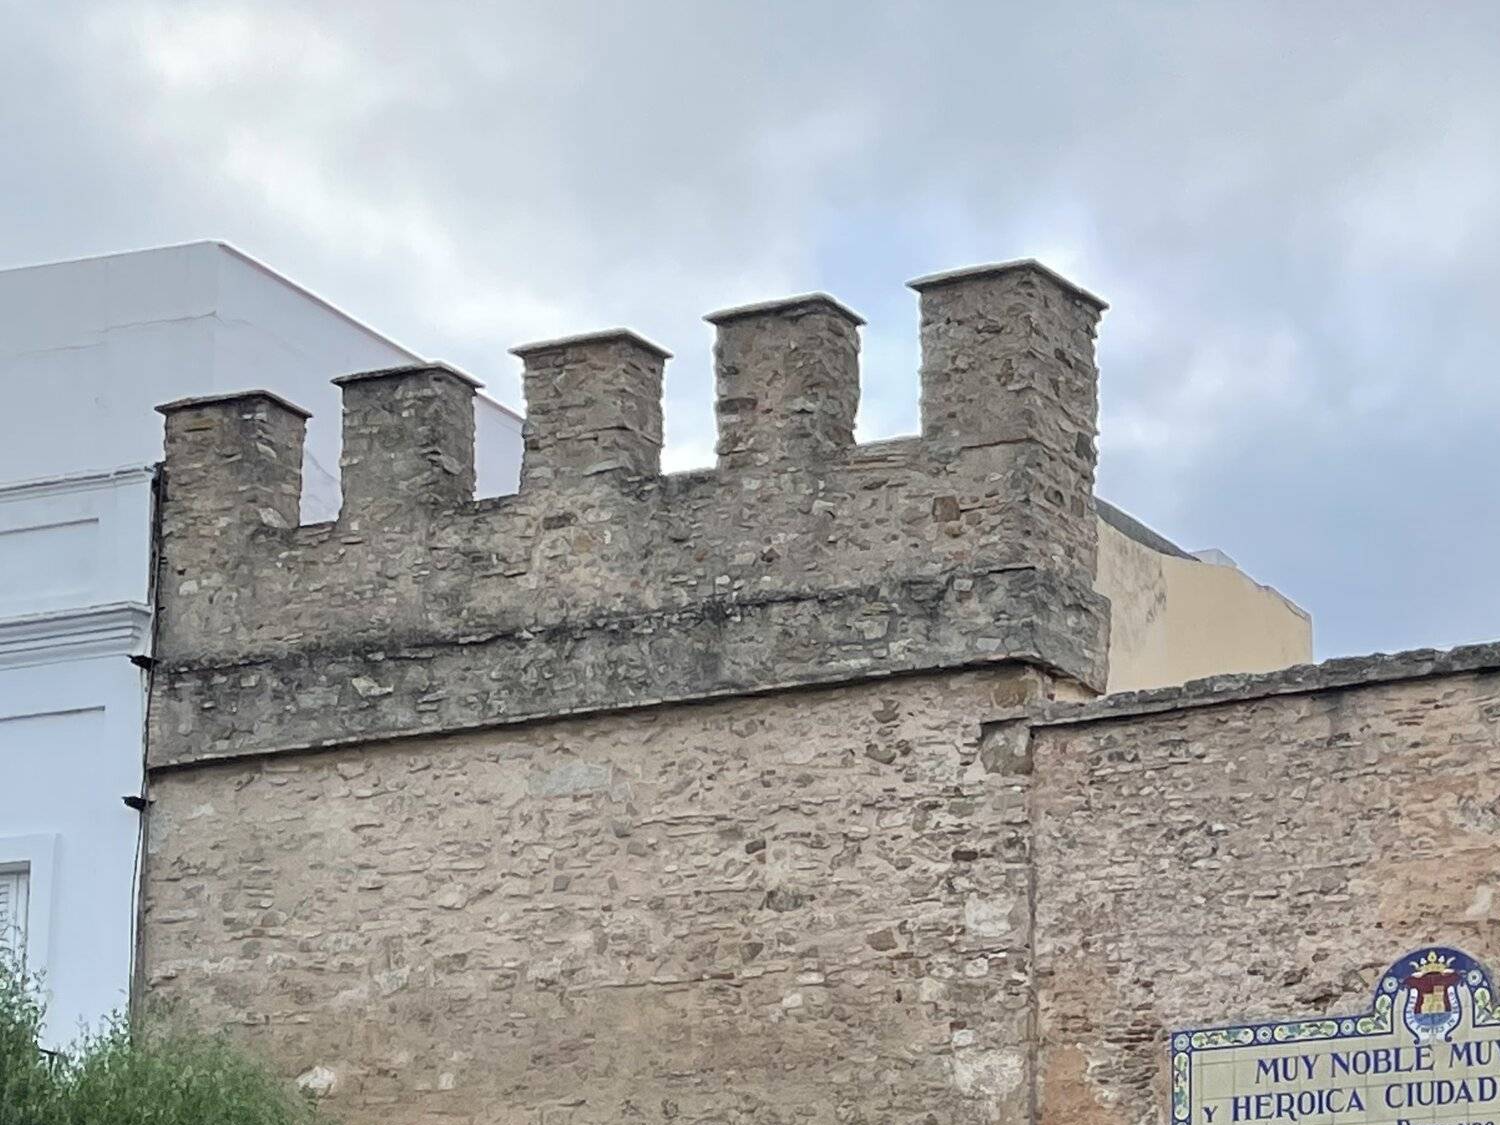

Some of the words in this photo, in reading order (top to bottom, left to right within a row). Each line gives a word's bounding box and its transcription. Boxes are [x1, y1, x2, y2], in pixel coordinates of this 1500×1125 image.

[1255, 1054, 1320, 1084] MUY
[1331, 1044, 1435, 1078] NOBLE
[1202, 1105, 1218, 1123] Y
[1232, 1088, 1366, 1122] HEROICA
[1385, 1077, 1497, 1109] CIUDAD
